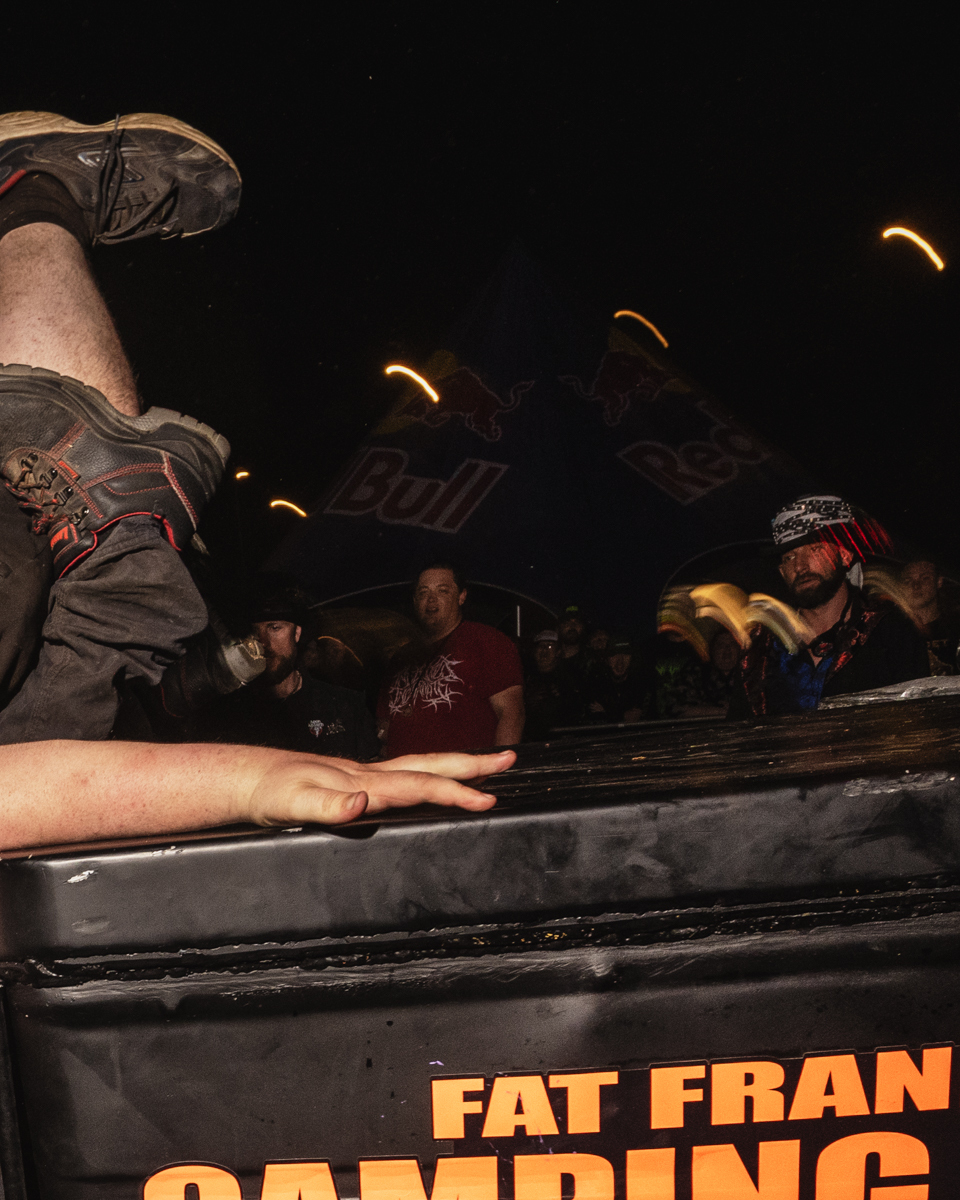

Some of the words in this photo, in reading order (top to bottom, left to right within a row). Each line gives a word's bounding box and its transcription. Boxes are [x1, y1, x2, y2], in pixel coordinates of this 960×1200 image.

[324, 446, 510, 534] Bull
[615, 399, 772, 505] Red
[431, 1071, 619, 1140] FAT
[650, 1046, 960, 1130] FRAN
